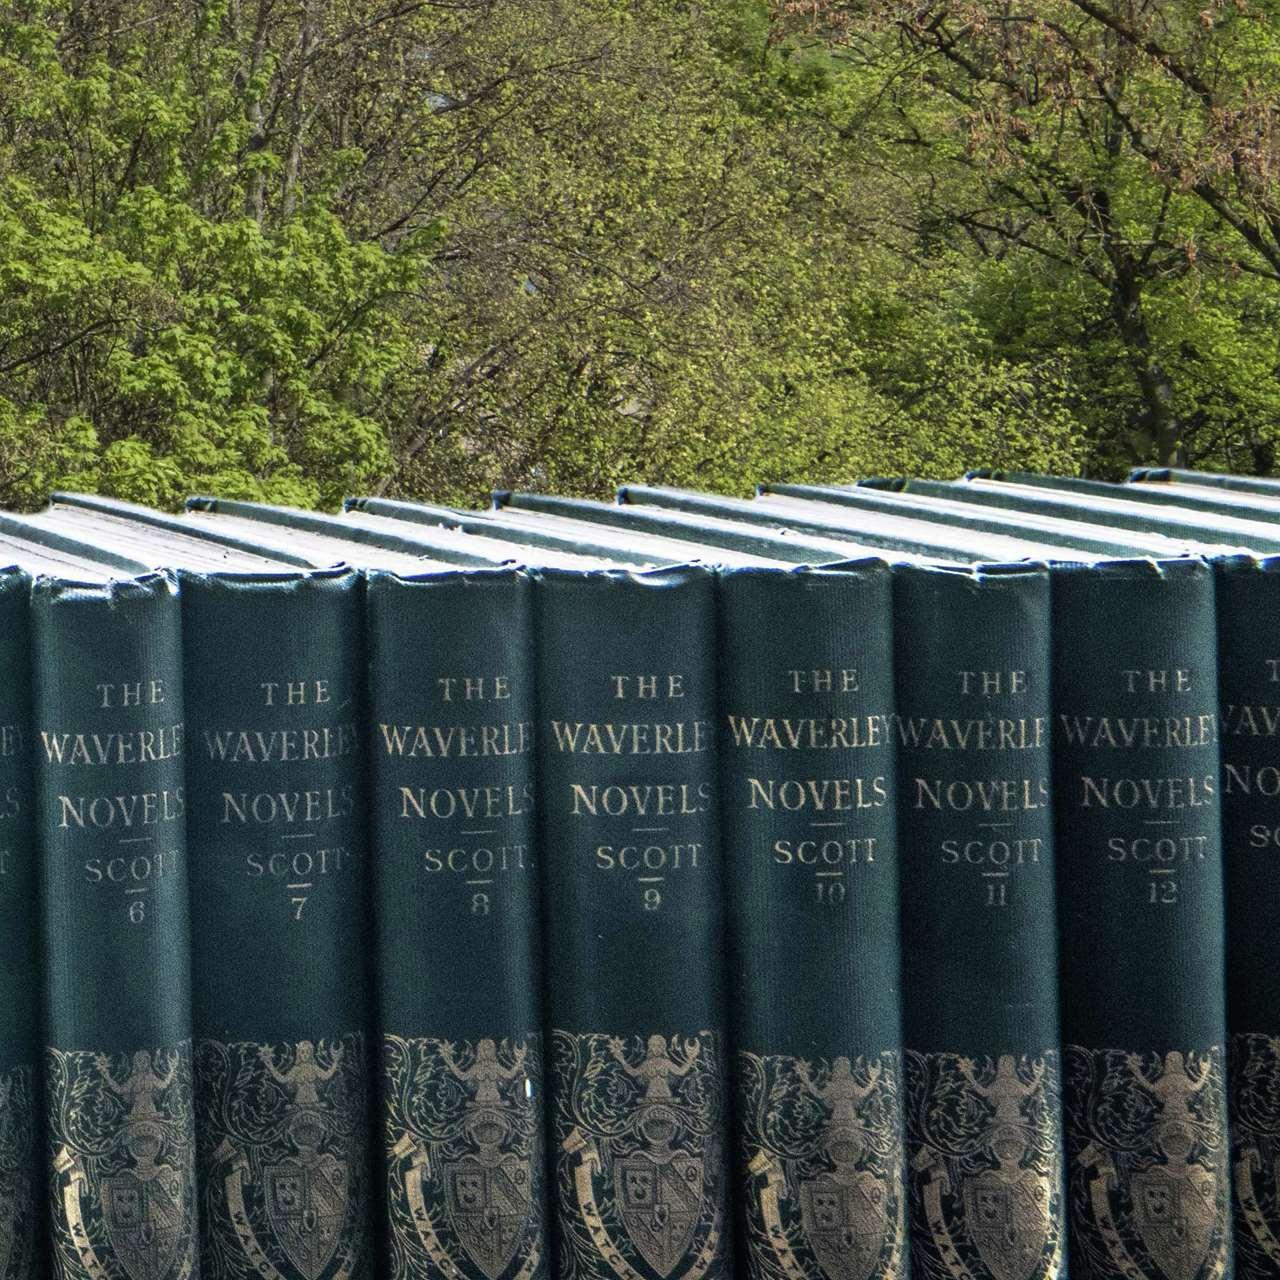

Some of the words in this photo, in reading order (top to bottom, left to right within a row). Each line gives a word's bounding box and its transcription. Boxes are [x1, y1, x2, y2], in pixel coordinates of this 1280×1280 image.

[96, 680, 166, 708] THE
[261, 681, 331, 706] THE
[438, 677, 510, 702] THE
[612, 675, 685, 699] THE
[788, 669, 860, 694] THE
[959, 670, 1026, 695] THE
[1123, 669, 1191, 693] THE
[41, 722, 185, 765] WAVERLE
[379, 720, 533, 758] WAVERLE
[552, 720, 708, 755] WAVERLE
[899, 717, 1044, 750] WAVERLE
[570, 783, 710, 816] NOVELS
[747, 777, 887, 811] NOVELS
[915, 776, 1048, 811] NOVELS
[1080, 775, 1215, 808] NOVELS
[58, 786, 184, 829] NOVELS
[246, 847, 346, 877] SCOTT
[596, 844, 702, 870] SCOTT
[773, 838, 877, 865] SCOTT
[941, 839, 1042, 864] SCOTT
[1107, 836, 1208, 862] SCOTT
[472, 893, 489, 915] 8
[644, 889, 661, 911] 9
[815, 883, 846, 904] 10
[1149, 881, 1177, 903] 12
[129, 901, 145, 924] 6
[291, 897, 308, 920] 7
